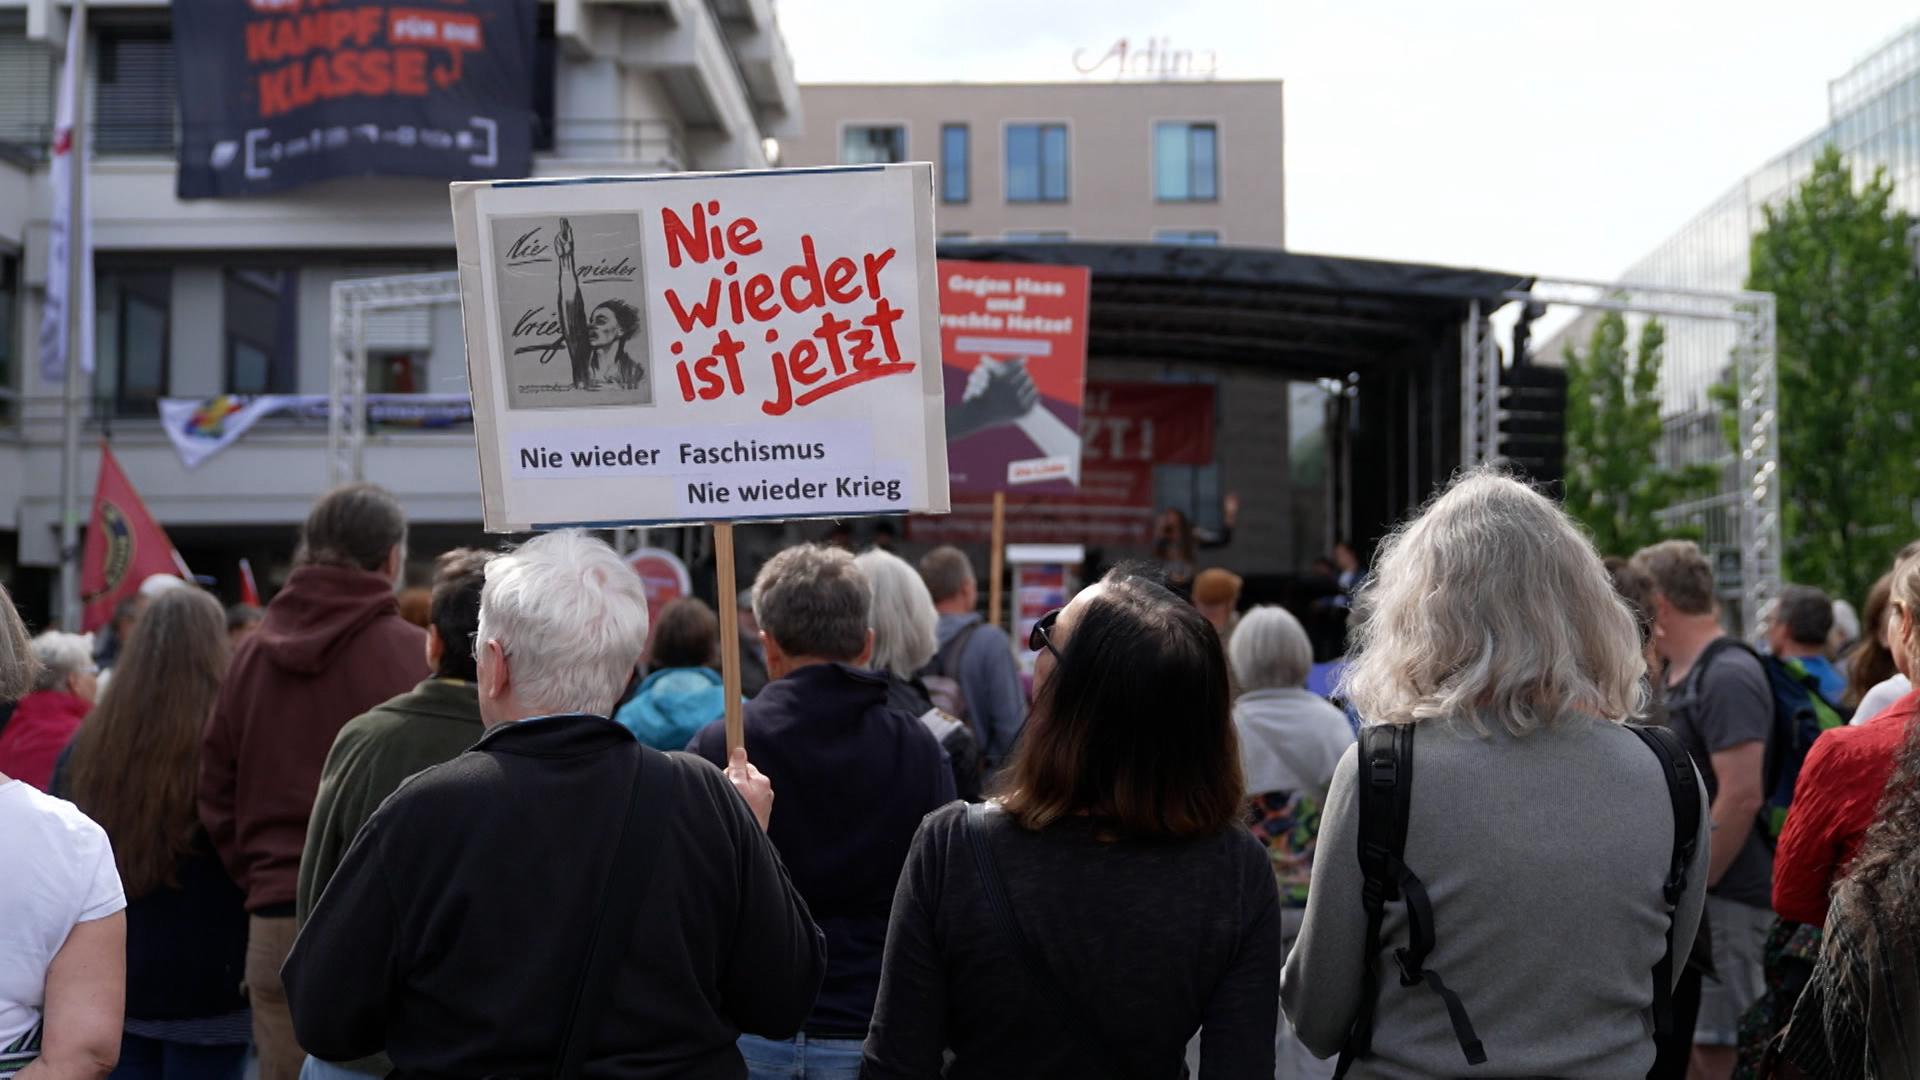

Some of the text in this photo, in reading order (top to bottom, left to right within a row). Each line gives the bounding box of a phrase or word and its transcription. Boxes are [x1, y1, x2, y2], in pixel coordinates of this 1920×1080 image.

[246, 6, 382, 61] KAMPF
[393, 15, 437, 40] FÜR
[259, 47, 428, 117] KLASSE
[506, 227, 549, 259] Nie
[661, 200, 763, 268] Nie
[576, 257, 636, 278] wieder
[664, 234, 896, 333] wieder
[948, 275, 1011, 298] Gegen
[986, 296, 1026, 312] und
[671, 298, 905, 416] ist jetzt
[520, 440, 825, 469] Nie wieder Faschismus
[688, 475, 901, 504] Nie wieder Krieg
